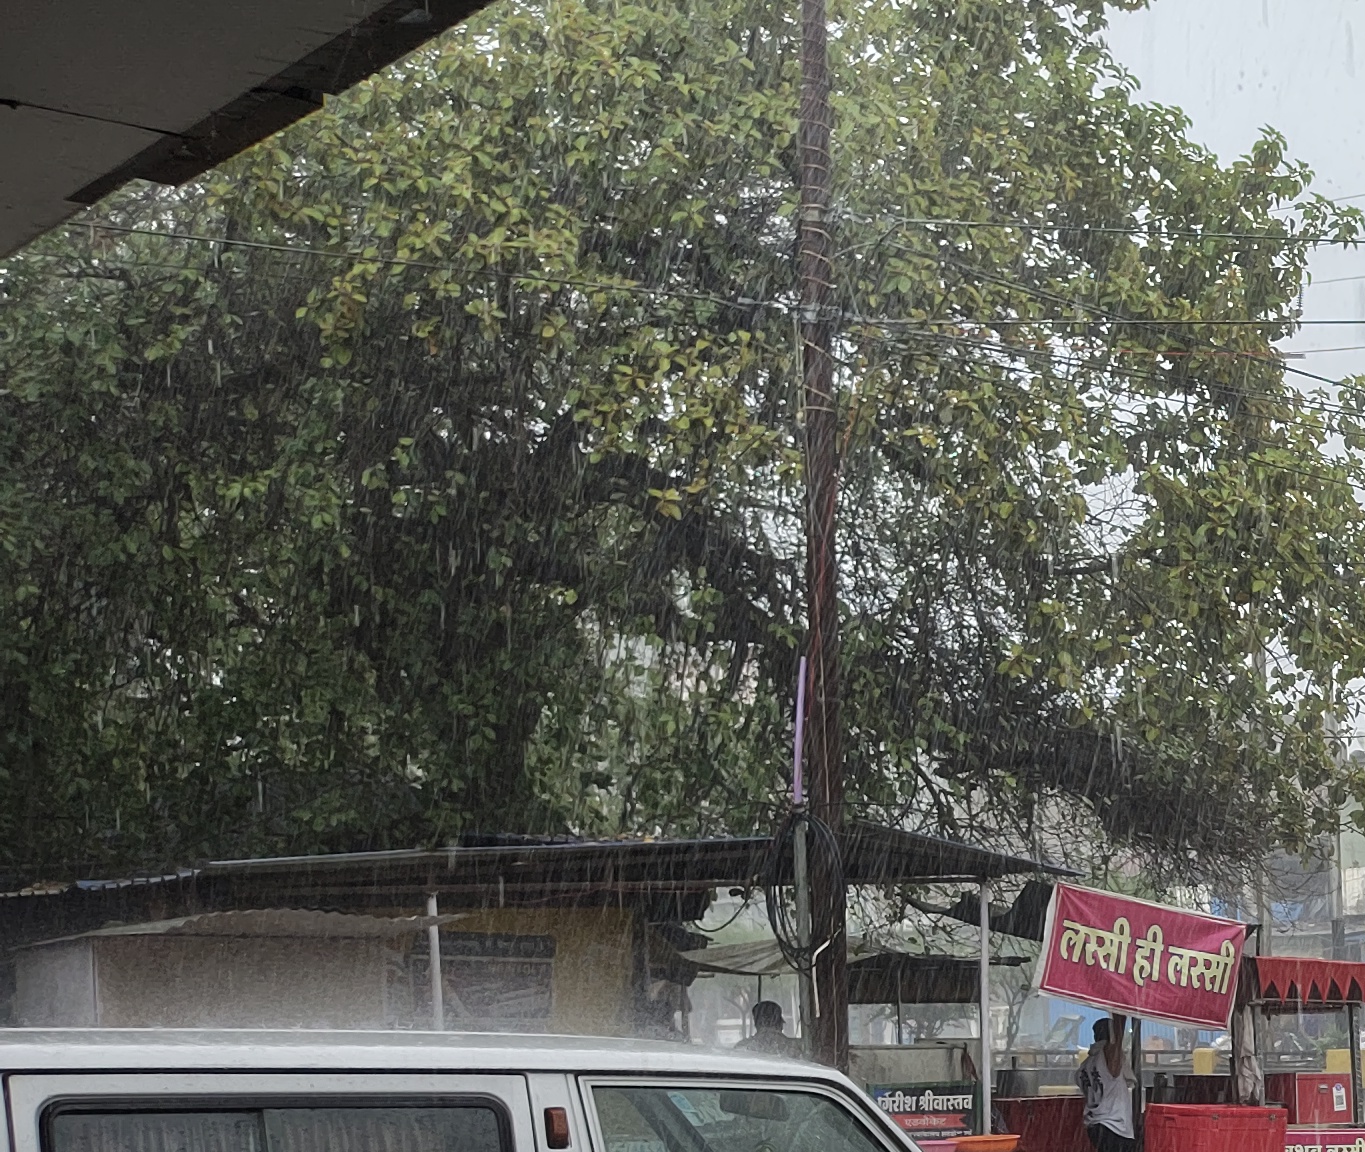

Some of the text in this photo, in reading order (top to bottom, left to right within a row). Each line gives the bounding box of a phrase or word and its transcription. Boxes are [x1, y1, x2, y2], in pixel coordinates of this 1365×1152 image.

[1060, 917, 1235, 995] लस्सी ही लस्सी
[919, 1090, 973, 1111] श्रीवास्तव
